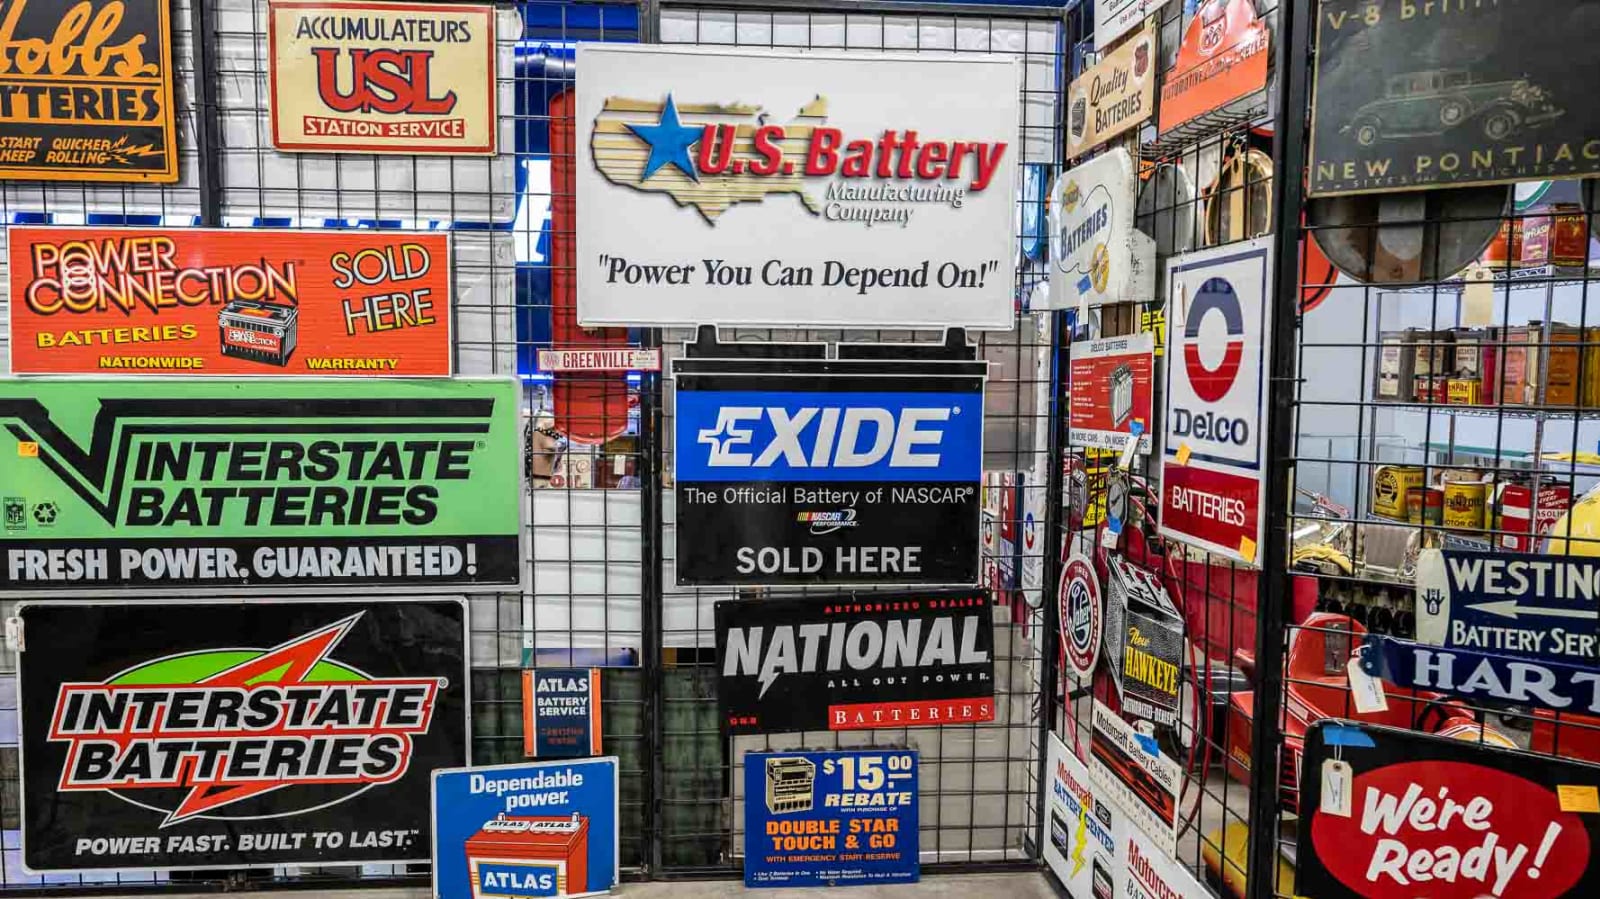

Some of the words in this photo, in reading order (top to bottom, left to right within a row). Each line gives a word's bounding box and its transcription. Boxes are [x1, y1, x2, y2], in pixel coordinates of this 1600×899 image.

[296, 15, 471, 43] ACCUMULATEURS
[1328, 5, 1380, 30] V-8
[311, 47, 457, 115] USL
[1090, 67, 1129, 107] Quality
[1095, 90, 1142, 133] BATTERIES
[305, 118, 382, 136] STATION
[388, 119, 463, 138] SERVICE
[0, 137, 42, 149] START
[53, 138, 111, 151] QUICKER
[0, 150, 36, 162] KEEP
[46, 152, 107, 164] ROLLING
[699, 122, 794, 176] U.S.
[805, 126, 1008, 191] Battery
[1317, 157, 1391, 182] NEW
[1417, 139, 1600, 174] PONTIAC
[826, 181, 966, 209] Manufacturing
[824, 203, 914, 227] Company
[1061, 203, 1107, 261] BATTERIES
[32, 237, 177, 271] POWER
[330, 243, 431, 289] SOLD
[599, 253, 696, 287] "Power
[702, 259, 752, 288] You
[761, 260, 813, 288] Can
[823, 260, 929, 295] Depend
[936, 259, 999, 290] On!"
[27, 261, 299, 315] CONNECTION
[343, 289, 436, 336] HERE
[37, 324, 199, 348] BATTERIES
[99, 357, 204, 369] NATIONWIDE
[307, 358, 398, 370] WARRANTY
[563, 352, 634, 368] GREENVILLE
[1173, 408, 1249, 446] Delco
[125, 486, 440, 527] BATTERIES
[684, 488, 717, 504] The
[724, 487, 786, 504] Official
[794, 488, 860, 506] Battery
[866, 488, 883, 504] of
[1172, 485, 1246, 527] BATTERIES
[812, 512, 841, 521] NASCAR
[8, 548, 107, 580] FRESH
[121, 547, 250, 580] POWER.
[253, 544, 478, 578] GUARANTEED!
[736, 546, 823, 573] SOLD
[836, 546, 922, 573] HERE
[1449, 557, 1600, 600] WESTIN
[824, 601, 920, 614] AUTHORIZED
[929, 598, 984, 609] DEALER
[1128, 627, 1151, 646] New
[1452, 620, 1547, 653] BATTERY
[1550, 627, 1600, 658] SER
[828, 679, 860, 689] ALL
[872, 677, 907, 686] OUT
[923, 673, 990, 684] POWER.
[1125, 646, 1178, 696] HAWKEYE
[537, 678, 588, 692] ATLAS
[537, 697, 588, 707] BATTERY
[539, 706, 586, 717] SERVICE
[835, 704, 989, 725] BATTERIES
[73, 734, 402, 781] BATTERIES
[1096, 710, 1129, 749] Motorcraft
[1129, 741, 1150, 769] Battery
[1150, 761, 1173, 787] Cables
[470, 768, 583, 796] Dependable
[1057, 757, 1095, 810] Motorcraft
[506, 790, 569, 812] power.
[824, 792, 912, 807] REBATE
[1360, 782, 1493, 836] We're
[766, 820, 840, 835] DOUBLE
[849, 818, 899, 833] STAR
[1054, 779, 1083, 820] BATTERY
[1086, 813, 1115, 857] CENTER
[75, 837, 161, 855] POWER
[166, 835, 229, 853] FAST.
[238, 833, 306, 852] BUILT
[314, 832, 344, 849] TO
[772, 836, 835, 851] TOUCH
[845, 835, 859, 849] &
[869, 834, 896, 849] GO
[788, 855, 836, 863] EMERGENCY
[840, 853, 863, 861] START
[866, 852, 901, 860] RESERVE
[1366, 821, 1563, 897] Ready!
[484, 871, 553, 890] ATLAS
